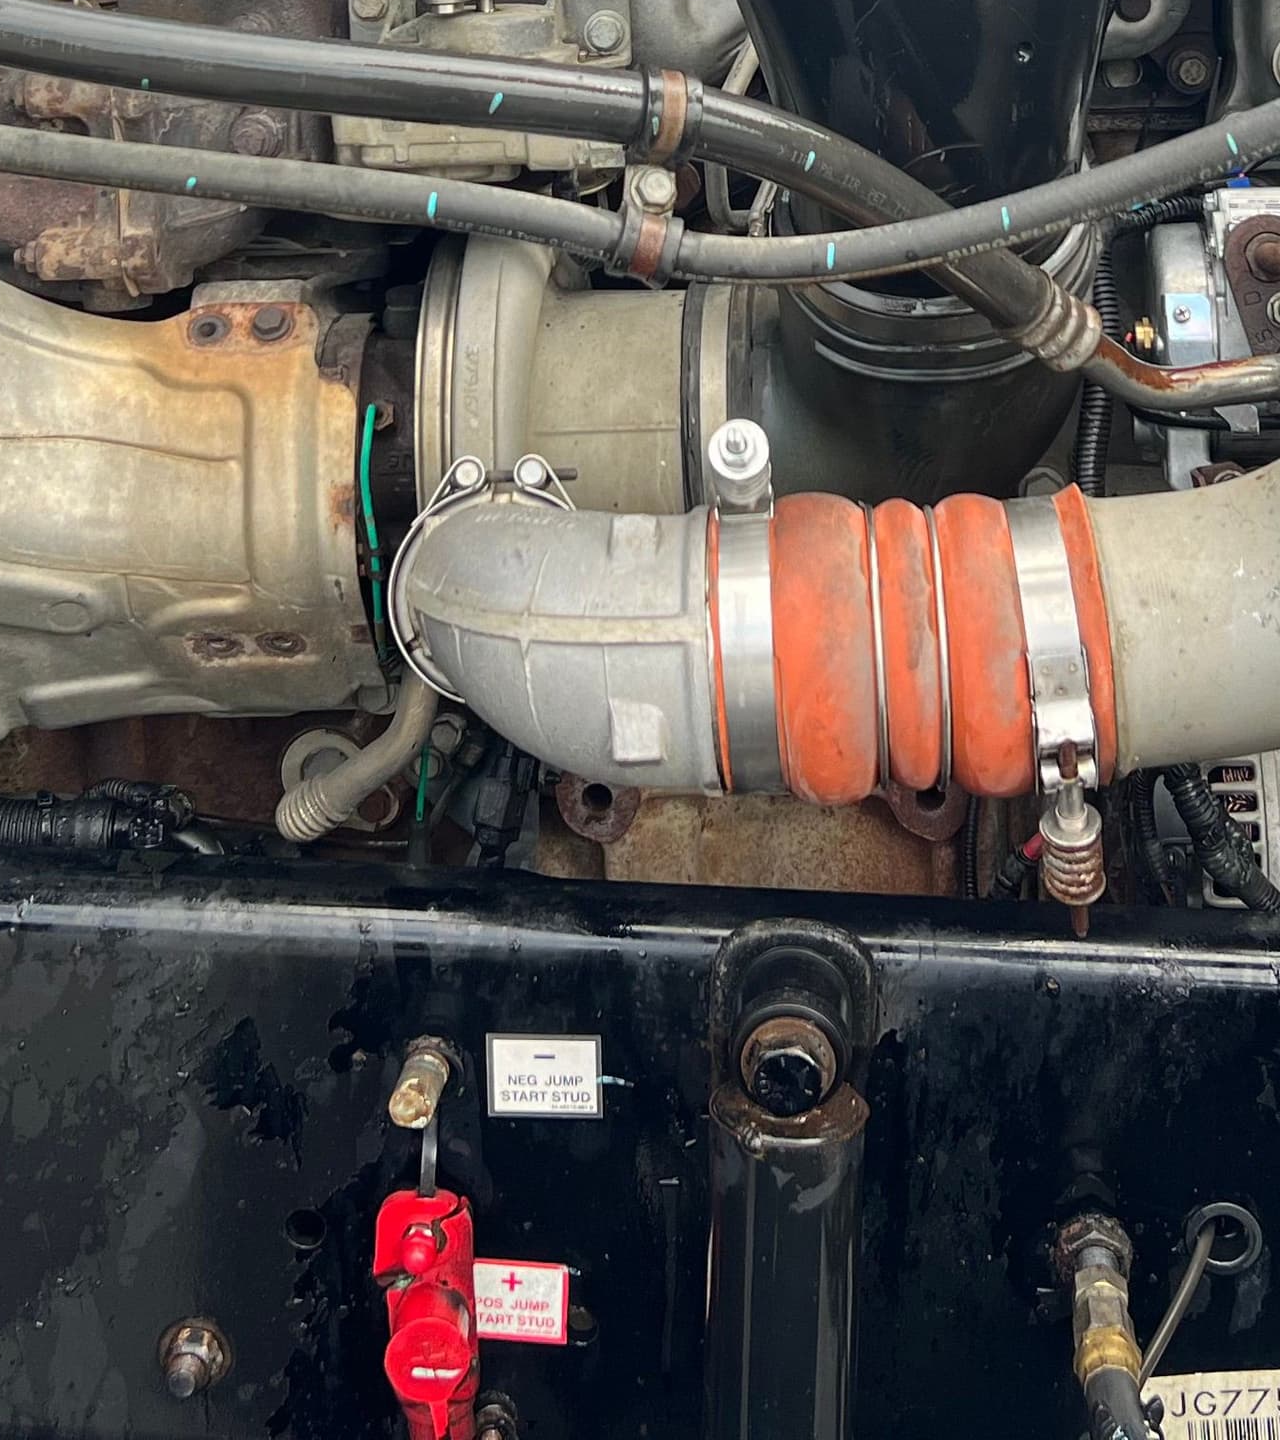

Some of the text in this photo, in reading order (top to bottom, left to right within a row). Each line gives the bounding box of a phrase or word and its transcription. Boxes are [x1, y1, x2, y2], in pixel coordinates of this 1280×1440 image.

[508, 1074, 583, 1087] NEG JUMP
[501, 1090, 591, 1103] START STUD
[511, 1299, 550, 1312] JUMP
[477, 1312, 555, 1328] TART STUD
